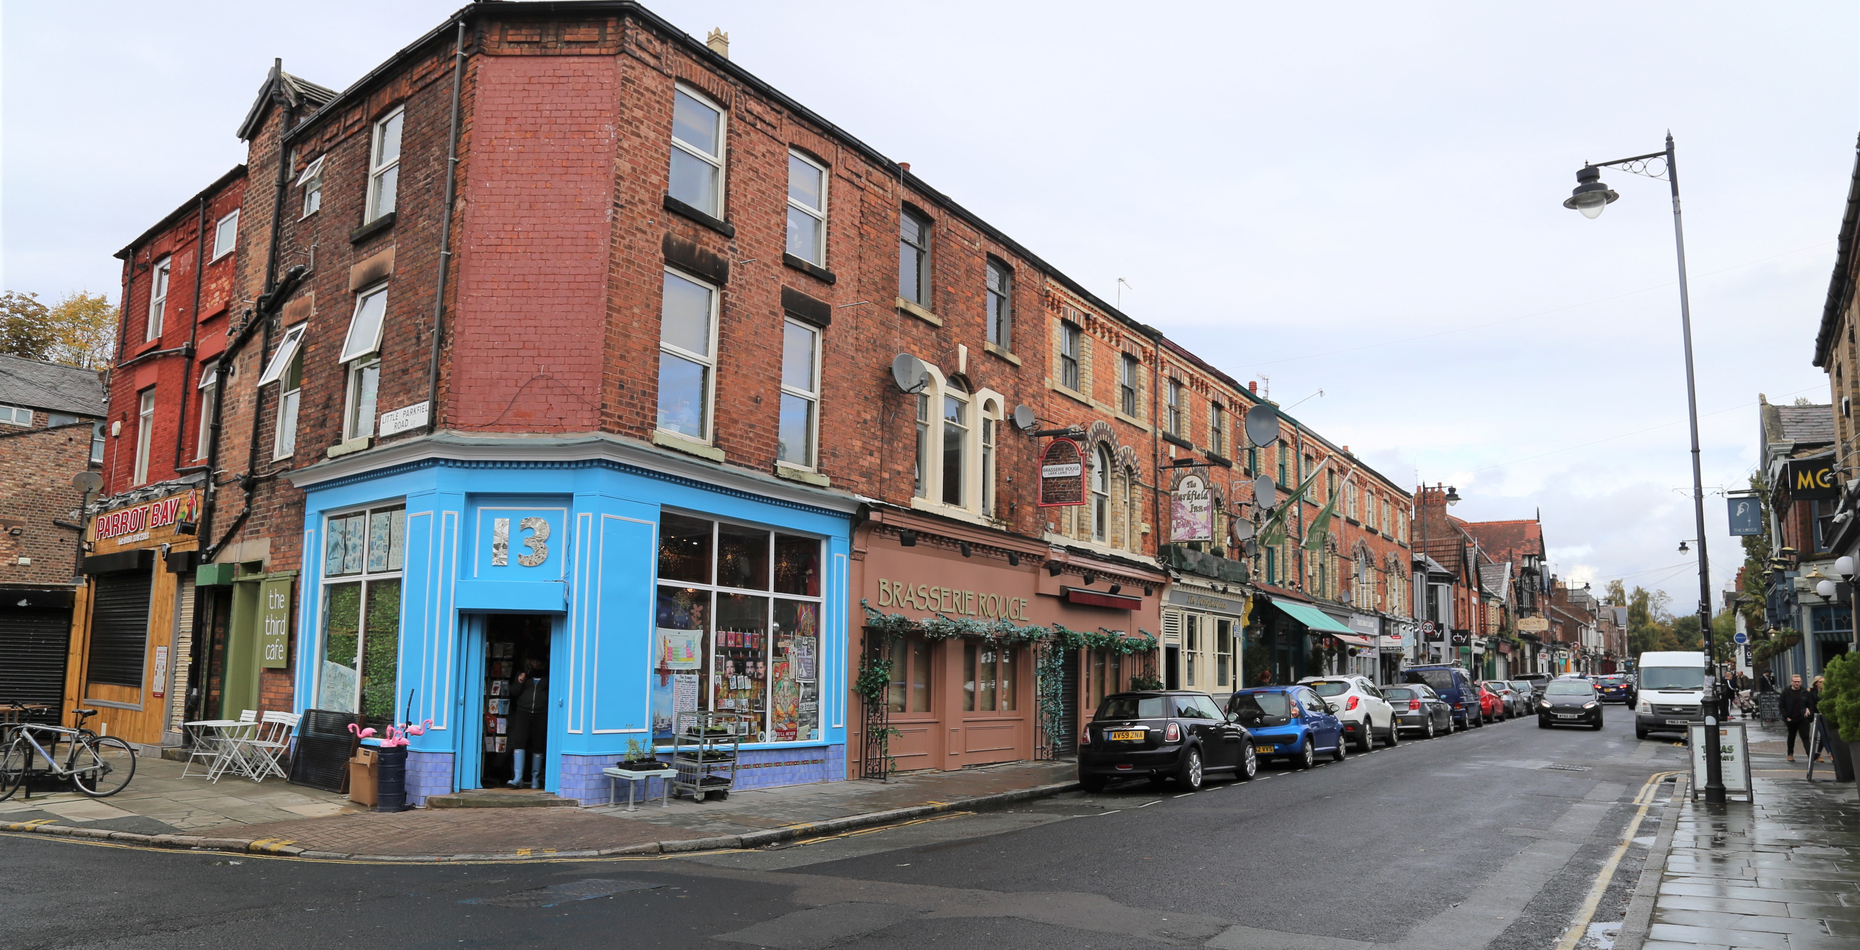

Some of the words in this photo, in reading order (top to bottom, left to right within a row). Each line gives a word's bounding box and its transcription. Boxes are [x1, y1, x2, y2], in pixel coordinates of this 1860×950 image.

[381, 412, 399, 425] LITTLE
[402, 403, 429, 418] PARKFIE
[393, 418, 409, 430] ROAD
[1186, 480, 1197, 489] The
[1172, 490, 1209, 503] Parkfield
[96, 505, 150, 541] PARROT
[149, 497, 180, 529] BAY
[1190, 504, 1204, 513] Inn
[491, 516, 551, 568] 13
[268, 588, 285, 610] the
[878, 578, 977, 617] BRASSERIE
[977, 592, 1030, 622] ROUGE
[265, 612, 287, 636] third
[265, 638, 284, 660] cafe
[1112, 731, 1130, 740] AV59
[1130, 731, 1143, 739] ZNA
[1701, 745, 1735, 754] TAS
